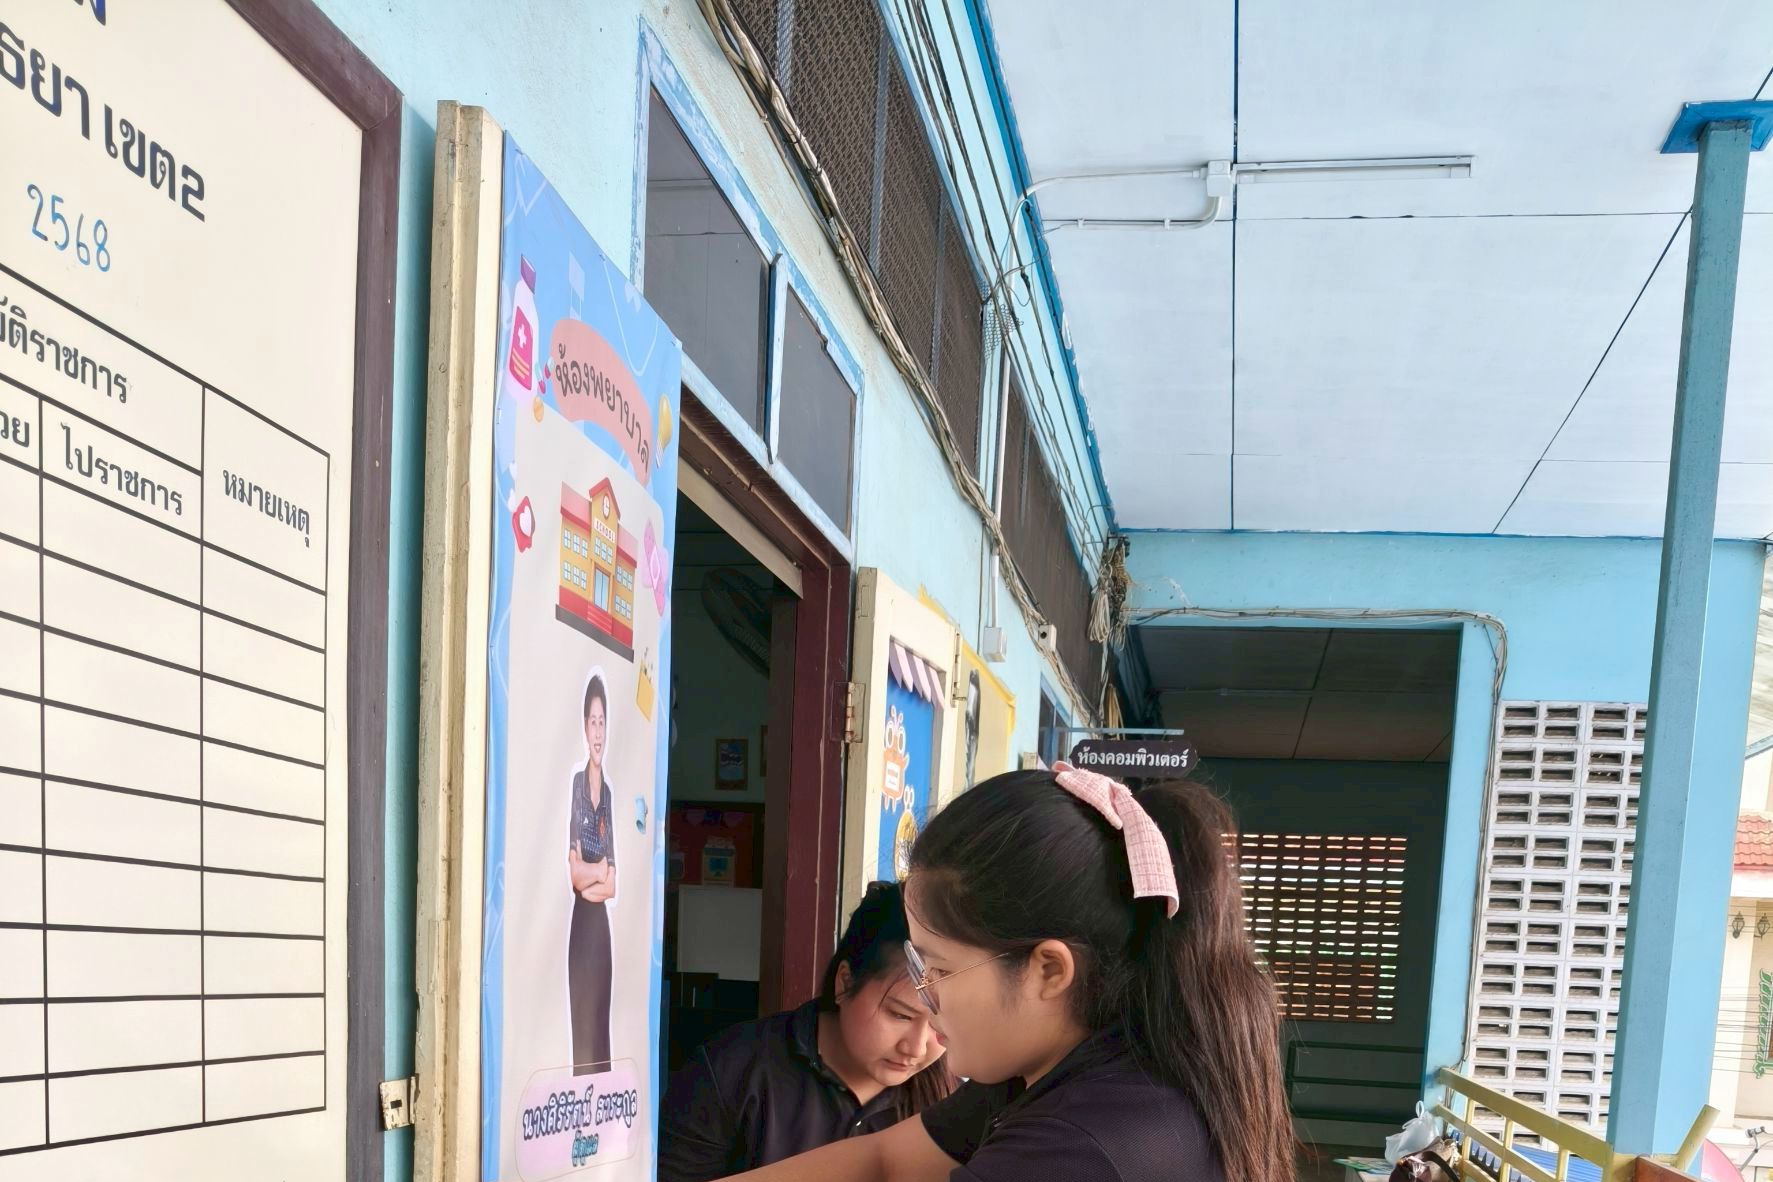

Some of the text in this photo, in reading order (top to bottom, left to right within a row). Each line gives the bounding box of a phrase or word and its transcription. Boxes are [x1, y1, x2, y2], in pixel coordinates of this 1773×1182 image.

[27, 183, 111, 272] 2568
[555, 343, 650, 474] ห้องพยาบาล
[60, 422, 182, 516] ไปราชการ
[223, 468, 310, 548] หมายเหตุ
[1078, 746, 1189, 767] ห้องคอมพิวเตอร์
